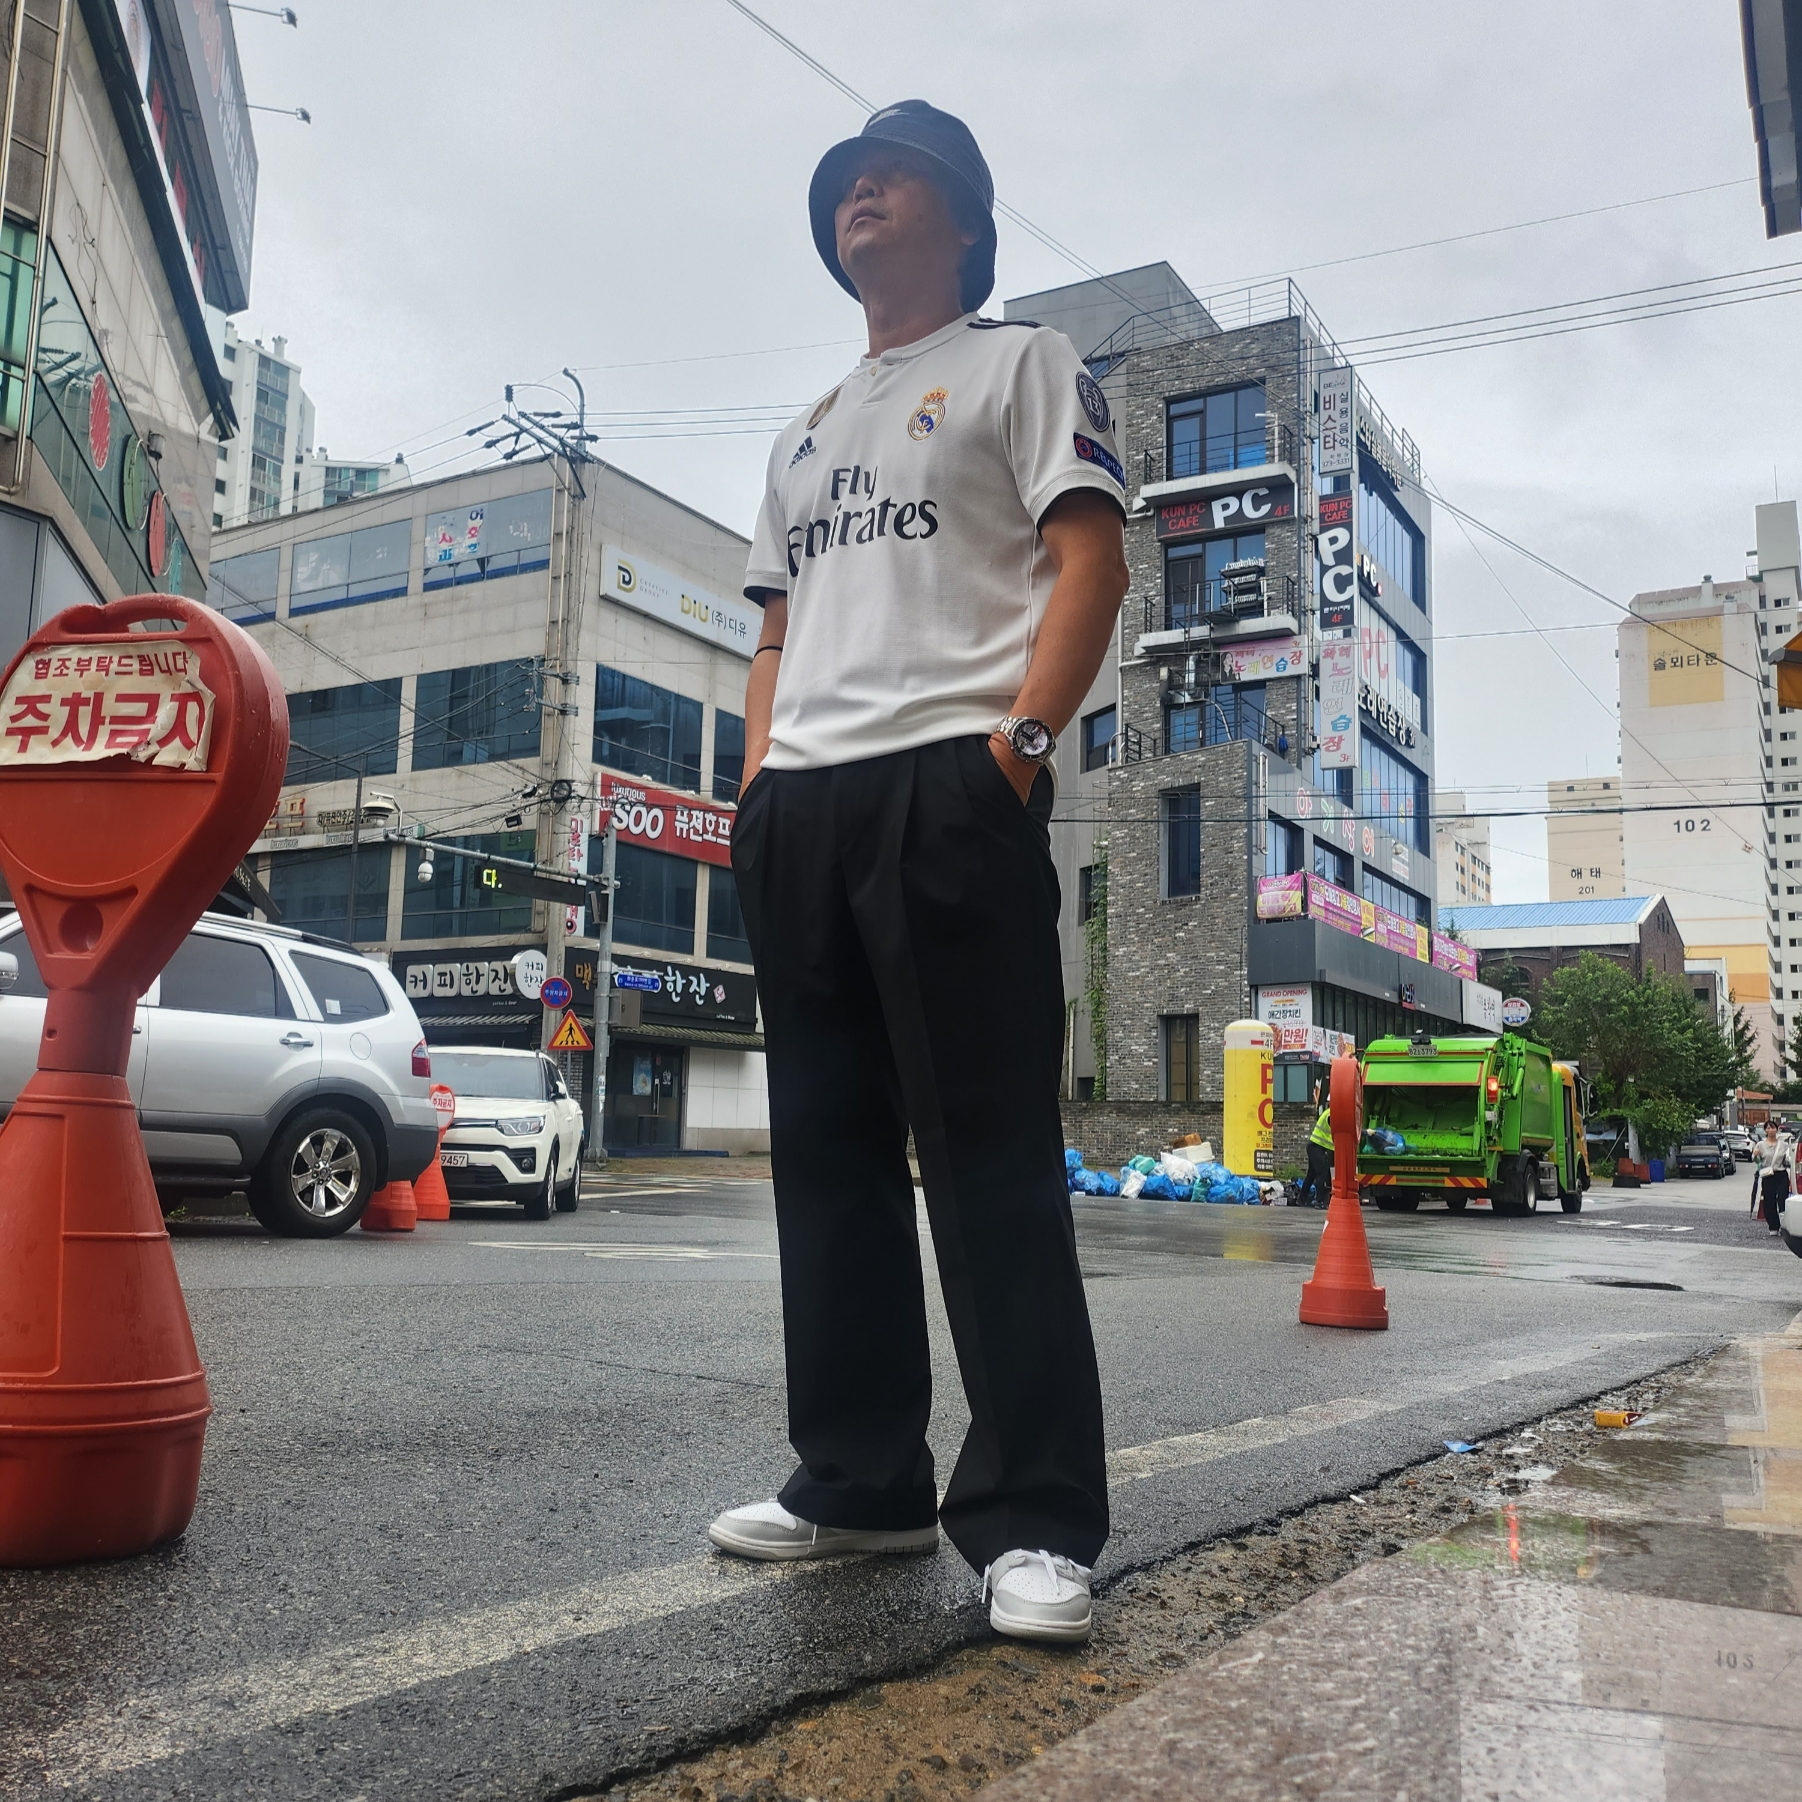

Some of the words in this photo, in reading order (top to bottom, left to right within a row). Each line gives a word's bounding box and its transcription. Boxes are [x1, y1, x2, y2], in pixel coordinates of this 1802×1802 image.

[1322, 393, 1338, 451] 비스타
[1339, 391, 1349, 449] 실용음악
[831, 465, 878, 501] Fly
[1161, 506, 1186, 520] KUN
[1189, 502, 1206, 515] PC
[1211, 487, 1272, 529] PC
[1274, 504, 1290, 517] 4F
[1320, 501, 1338, 513] KUN
[1340, 500, 1352, 511] PC
[1168, 515, 1200, 530] CAFE
[1325, 510, 1348, 521] CAFE
[1317, 527, 1354, 603] PC
[1331, 613, 1342, 623] 4F
[1360, 627, 1388, 680] PC
[1653, 652, 1718, 671] 솔뫼타운
[34, 651, 189, 680] 협조부탁드립니다
[1234, 650, 1303, 675] 노래연습장
[1322, 663, 1355, 753] 노래연습장
[612, 797, 665, 840] SOO
[675, 804, 731, 847] 퓨전호프
[1672, 819, 1712, 833] 102
[1578, 886, 1595, 895] 201
[525, 961, 544, 971] 커피
[524, 975, 545, 989] 한잔
[1261, 990, 1281, 998] GRAND
[1282, 988, 1307, 997] OPENING
[1283, 1028, 1308, 1044] 만원!
[432, 1098, 452, 1108] 주차금지
[441, 1155, 465, 1166] 9457
